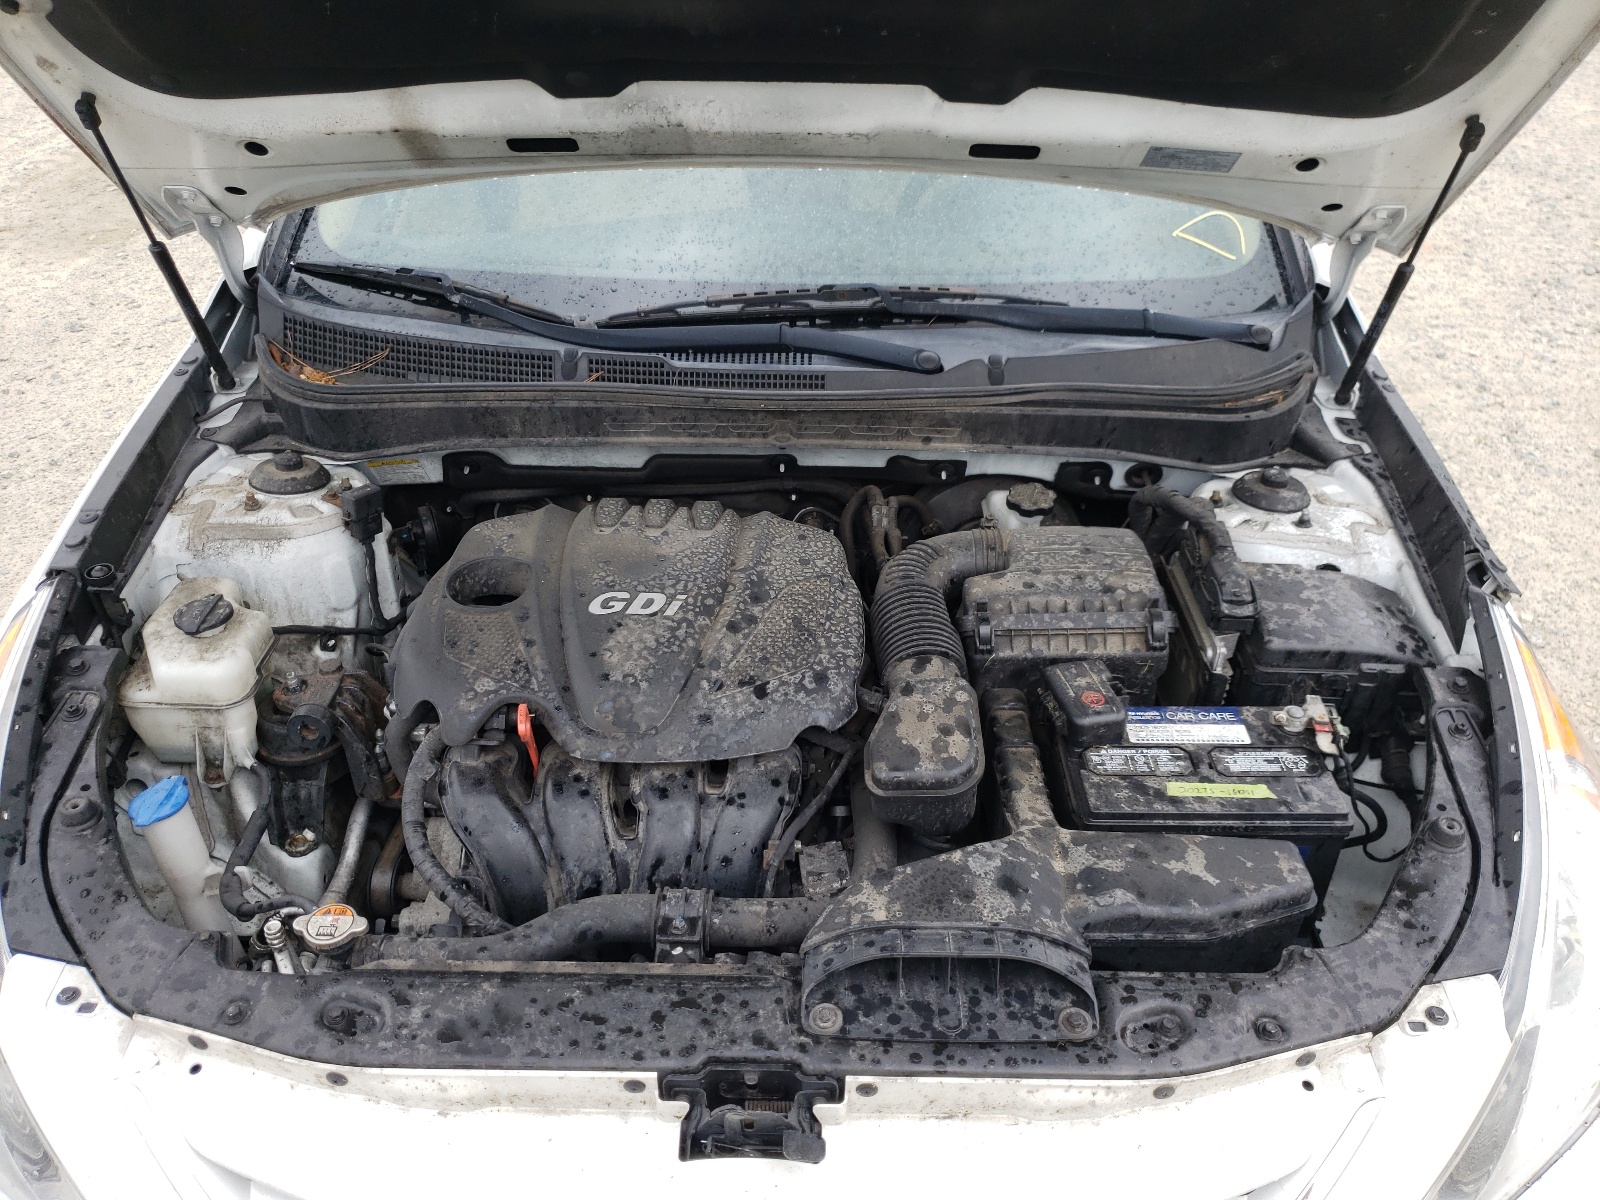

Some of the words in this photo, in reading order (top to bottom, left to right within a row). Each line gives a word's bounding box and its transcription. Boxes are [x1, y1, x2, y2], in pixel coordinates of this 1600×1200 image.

[588, 591, 688, 616] GDi
[1166, 711, 1195, 720] CAR
[1198, 712, 1237, 721] CARE
